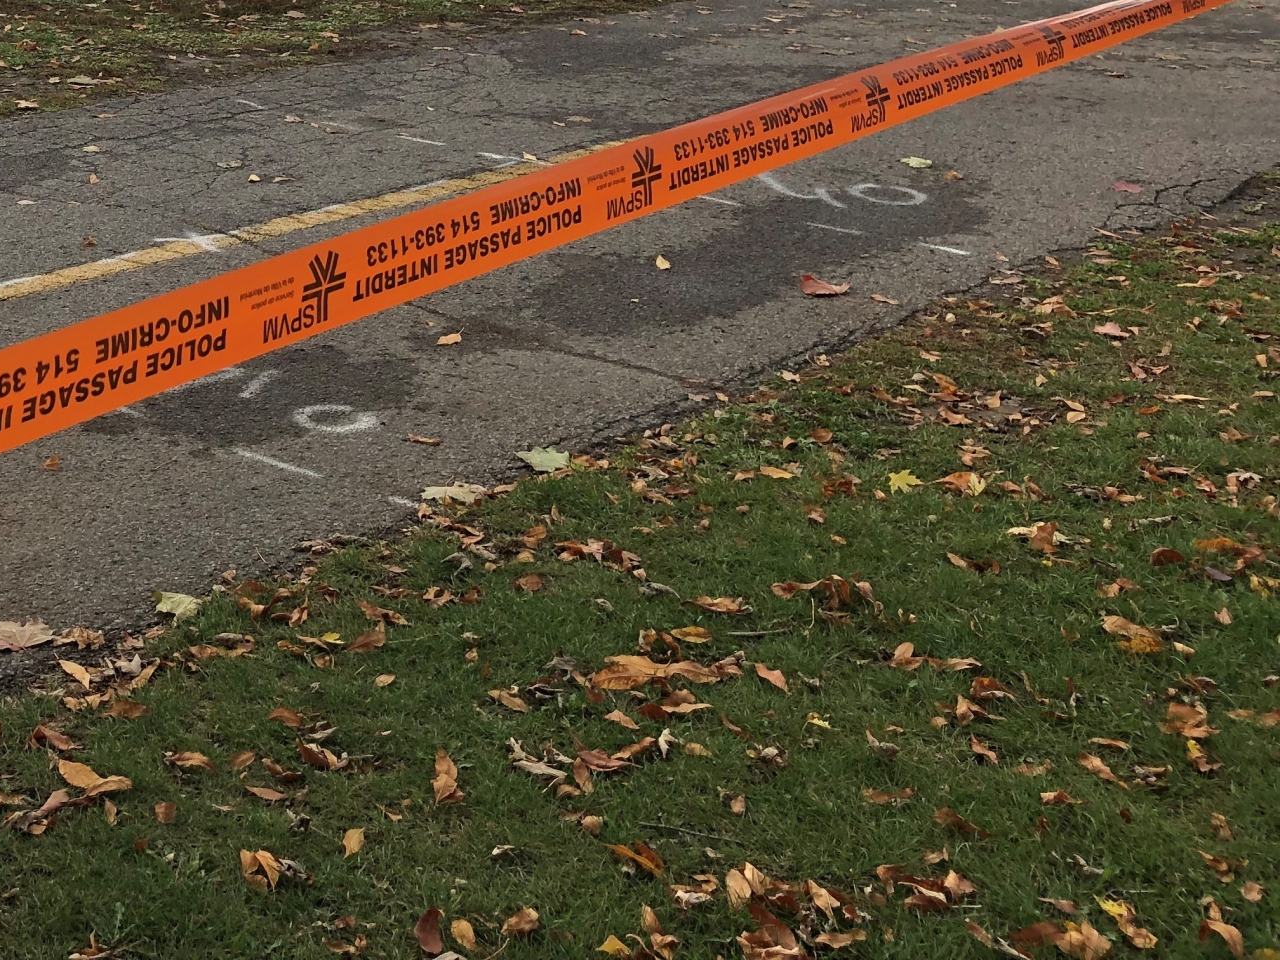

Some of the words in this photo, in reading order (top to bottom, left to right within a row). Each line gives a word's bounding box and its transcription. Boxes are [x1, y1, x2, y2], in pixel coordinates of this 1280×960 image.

[1108, 12, 1145, 35] PASSAGE
[1144, 2, 1172, 23] POLICE
[1071, 25, 1110, 49] INTERDIT
[989, 54, 1023, 77] POLICE
[1036, 47, 1058, 67] SPVM
[897, 81, 944, 110] INTERDIT
[944, 65, 989, 93] PASSAGE
[732, 120, 755, 141] 514
[759, 96, 828, 132] INFO-CRIME
[851, 108, 879, 133] SPVM
[674, 128, 731, 161] 393-1133
[791, 119, 833, 147] POLICE
[732, 134, 789, 168] PASSAGE
[669, 154, 730, 191] INTERDIT
[489, 177, 582, 226] INFO-CRIME
[607, 191, 643, 220] SPVM
[451, 211, 480, 238] 514
[527, 204, 582, 241] POLICE
[366, 222, 445, 267] 393-1133
[444, 225, 521, 270] PASSAGE
[352, 254, 438, 302] INTERDIT
[95, 295, 230, 364] INFO-CRIME
[263, 304, 315, 344] SPVM
[36, 348, 80, 385] 514
[145, 328, 227, 378] POLICE
[21, 360, 138, 423] PASSAGE
